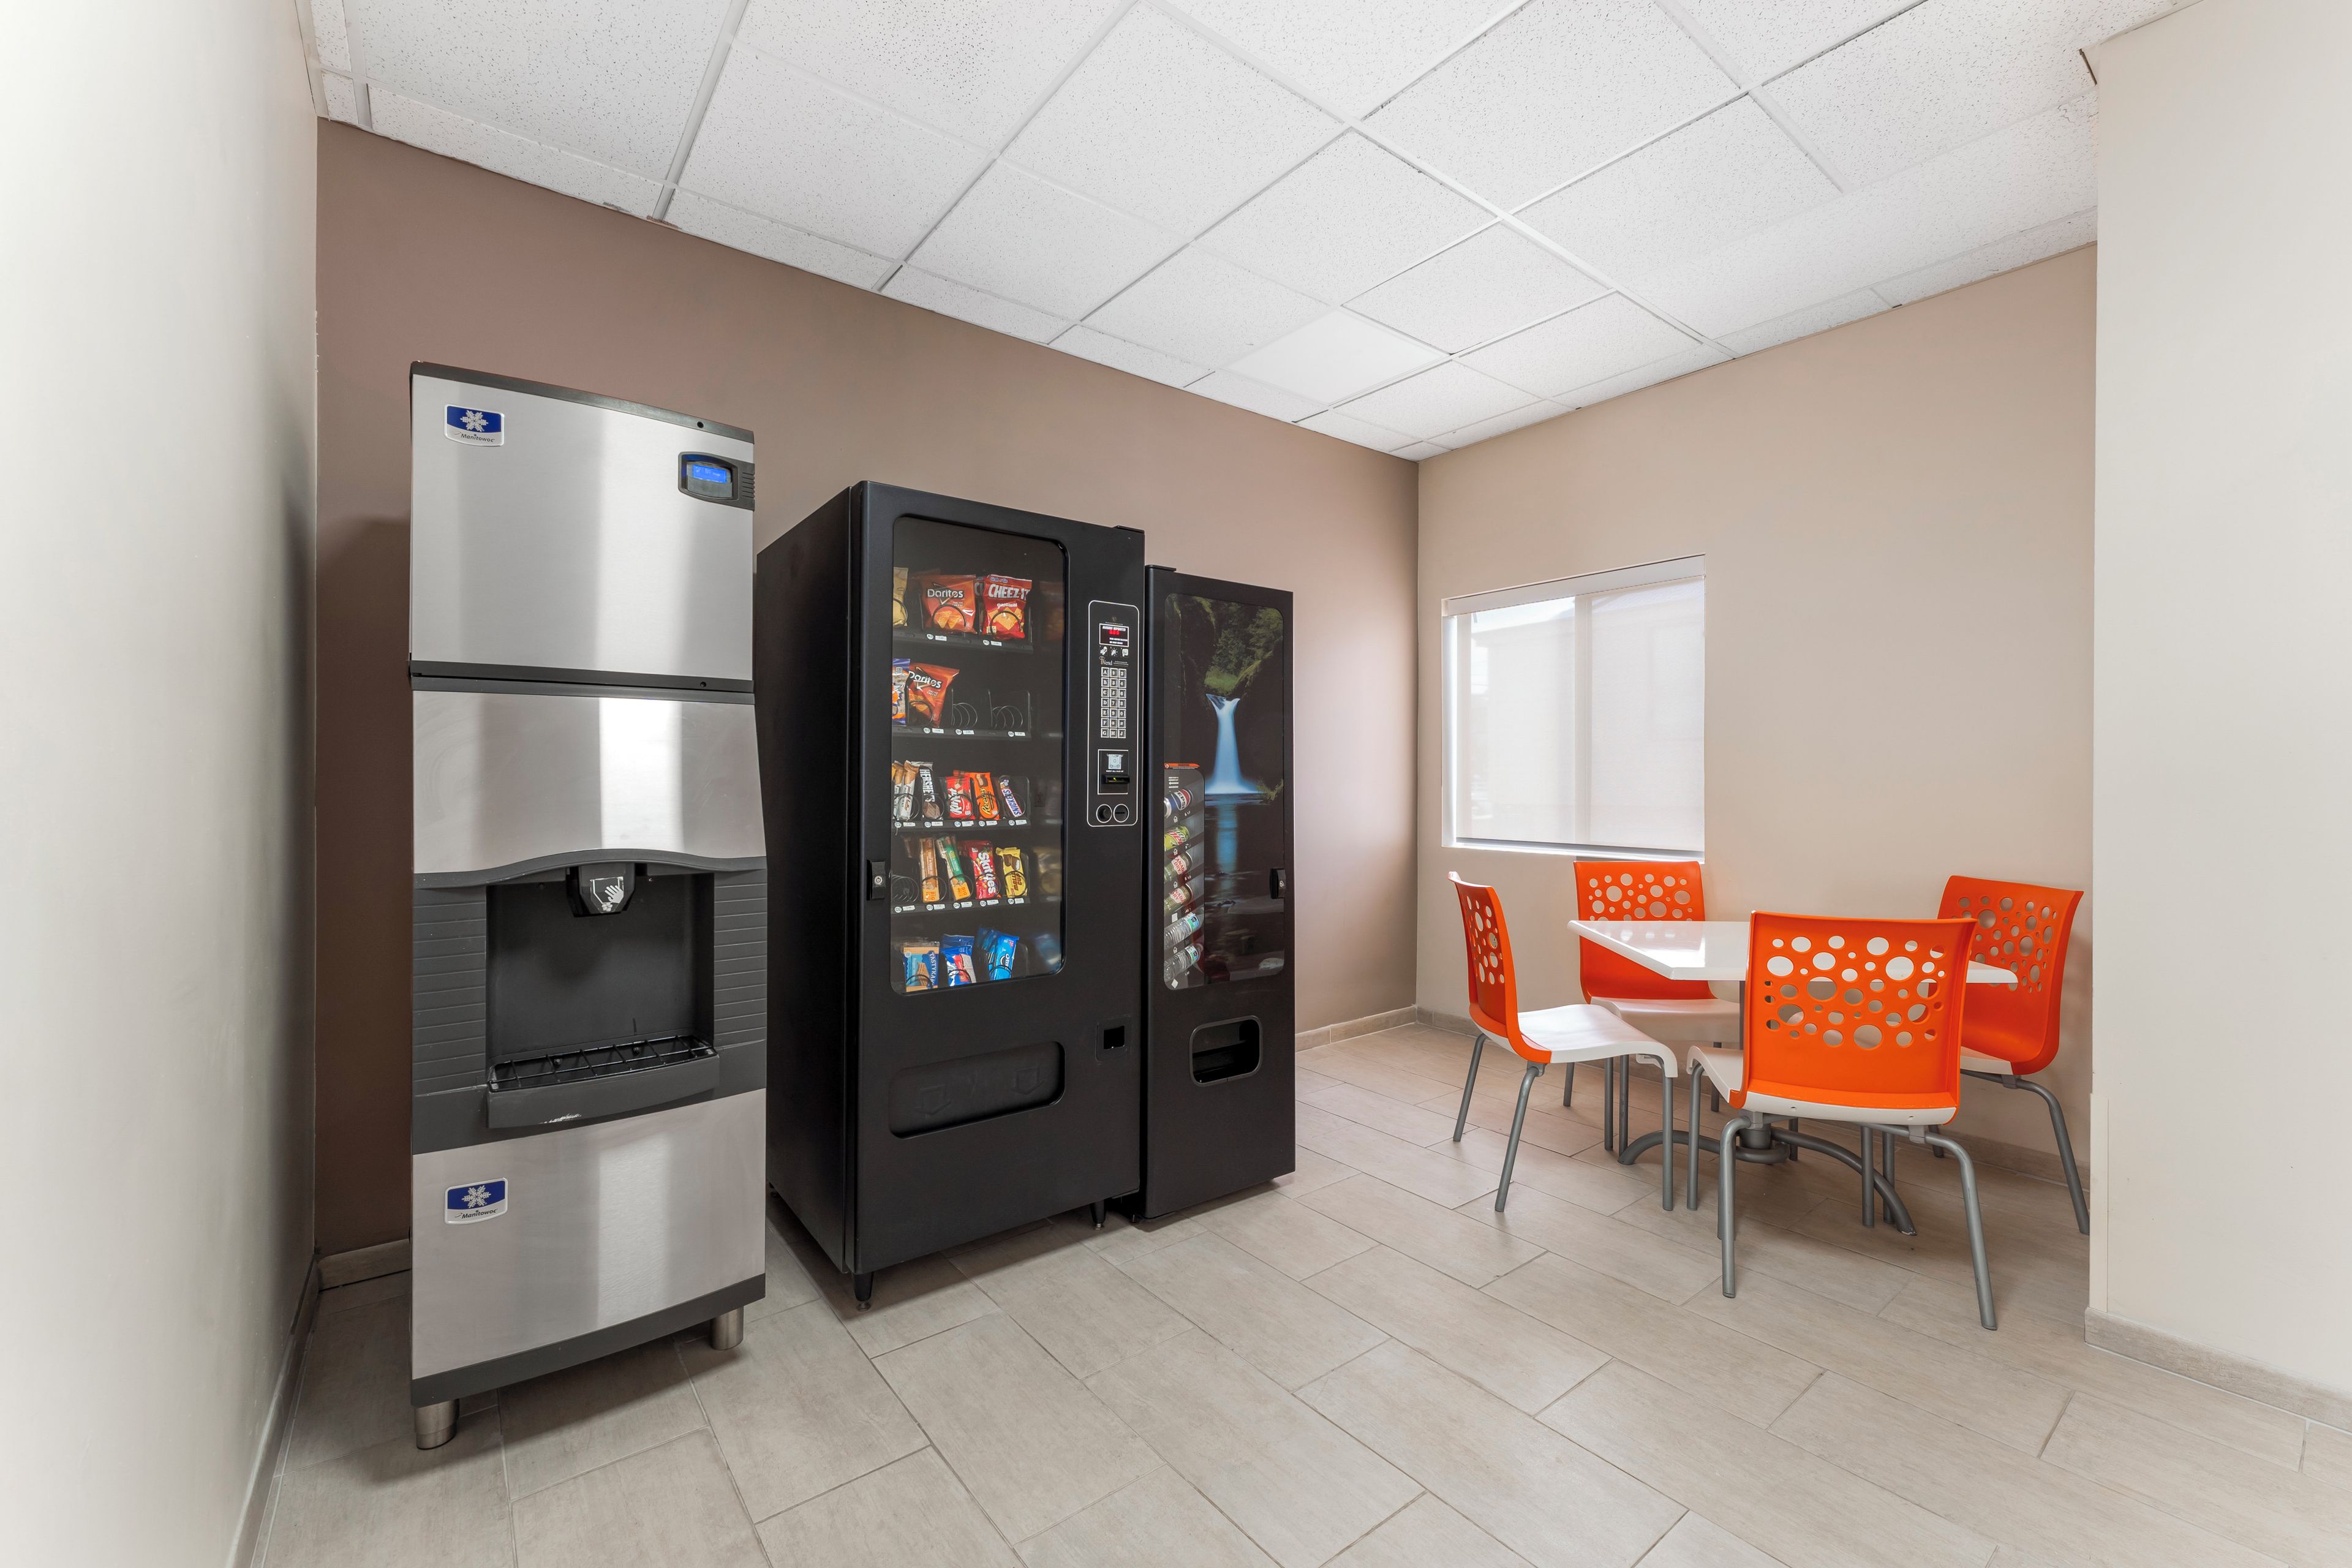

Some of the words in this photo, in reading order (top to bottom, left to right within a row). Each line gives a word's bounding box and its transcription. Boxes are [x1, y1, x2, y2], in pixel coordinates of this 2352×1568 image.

[461, 433, 495, 442] Manitowoc
[927, 589, 963, 598] Doritos
[988, 583, 1030, 600] CHEEZ-IT
[908, 671, 942, 688] Doritos
[1003, 790, 1022, 816] SNICKERS
[978, 852, 996, 894] Skittles
[929, 952, 937, 985] TASTYKAK
[461, 1208, 498, 1219] Manitowoc
